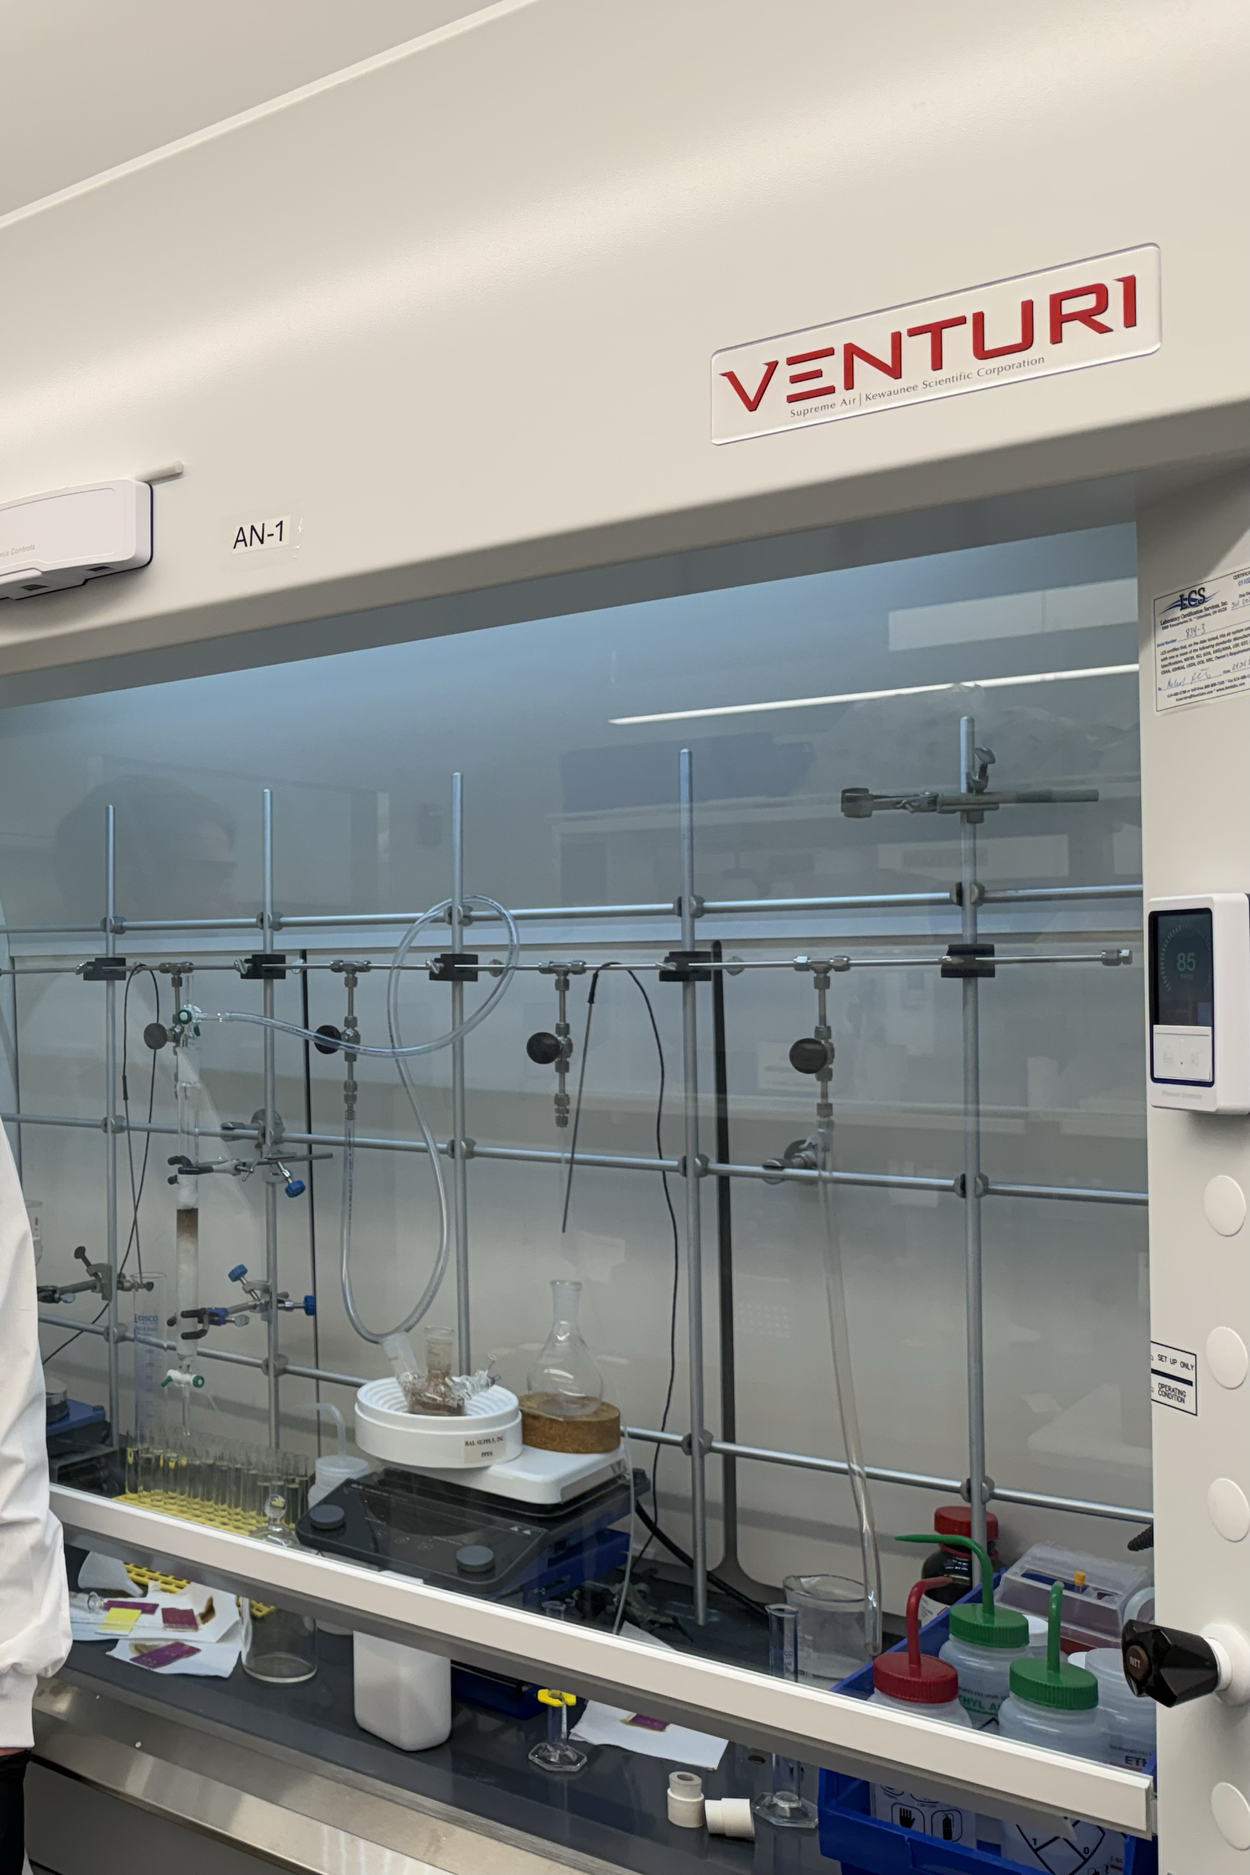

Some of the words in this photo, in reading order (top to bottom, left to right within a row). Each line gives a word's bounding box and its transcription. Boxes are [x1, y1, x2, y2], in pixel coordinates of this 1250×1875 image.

[718, 274, 1137, 412] VENTURI
[790, 402, 836, 418] Supreme
[840, 397, 856, 408] Air
[865, 384, 919, 402] Kewaunee
[922, 372, 973, 390] Scientific
[976, 356, 1045, 377] Corporation
[233, 520, 283, 549] AN-1
[10, 544, 36, 556] Controls
[1179, 587, 1206, 611] LCS
[1177, 952, 1196, 972] 85
[1157, 1354, 1167, 1363] SET
[1180, 1361, 1194, 1371] ONLY
[1158, 1382, 1186, 1398] OPERATING
[1158, 1389, 1185, 1404] CONDITION
